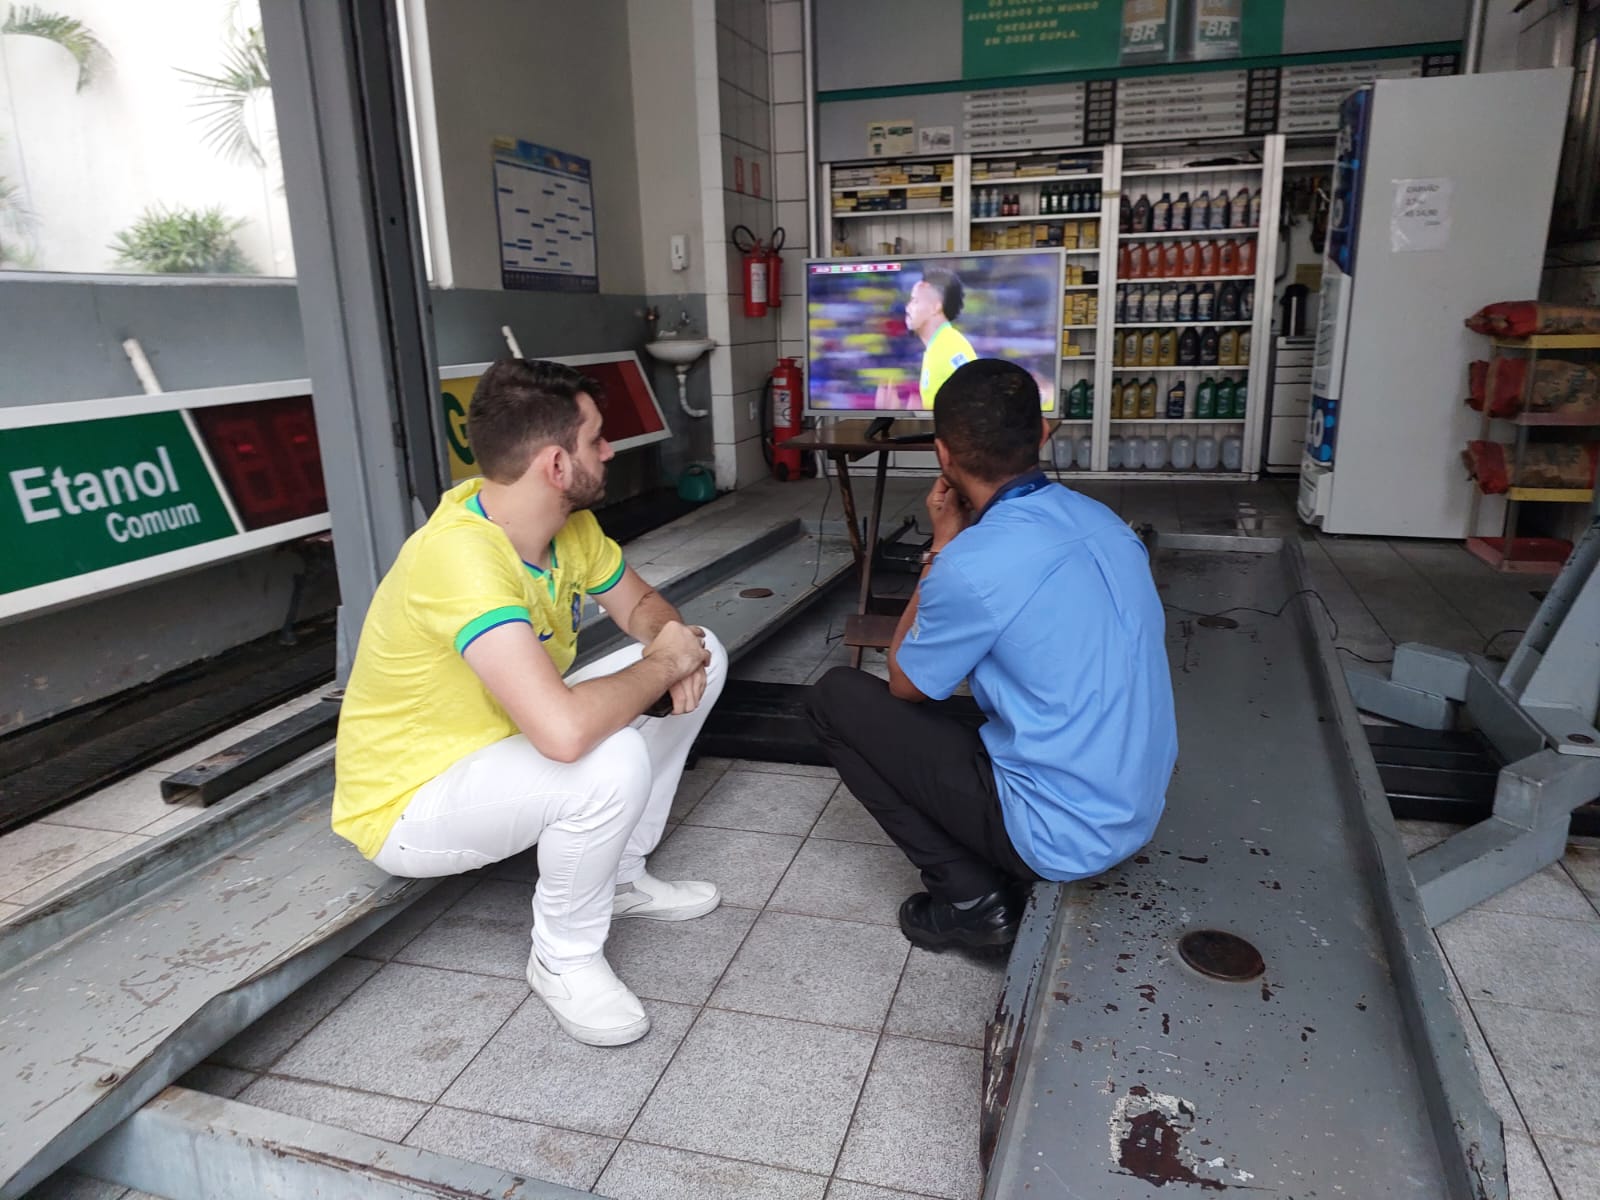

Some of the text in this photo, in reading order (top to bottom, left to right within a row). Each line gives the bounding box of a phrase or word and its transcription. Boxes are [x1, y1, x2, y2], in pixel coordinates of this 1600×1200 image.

[1130, 23, 1157, 42] BR
[1205, 20, 1231, 36] BR
[9, 446, 179, 524] Etanol
[106, 502, 200, 543] Comum
